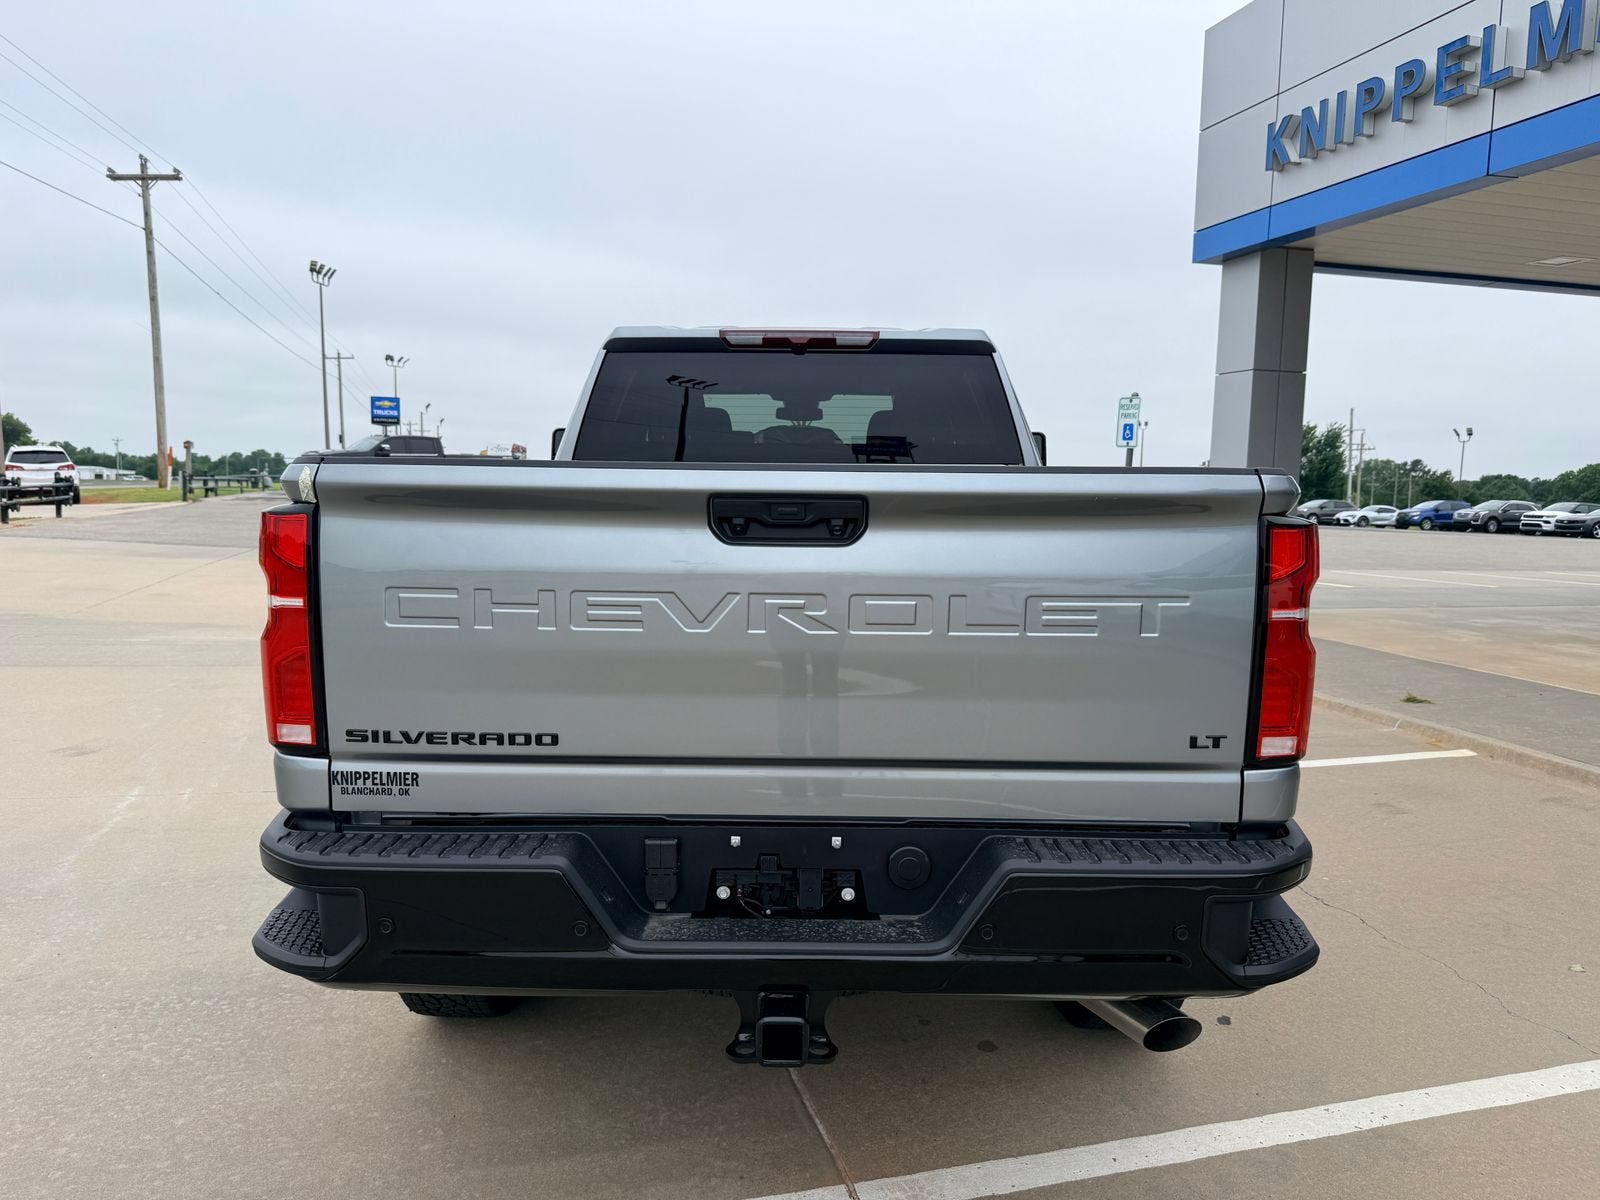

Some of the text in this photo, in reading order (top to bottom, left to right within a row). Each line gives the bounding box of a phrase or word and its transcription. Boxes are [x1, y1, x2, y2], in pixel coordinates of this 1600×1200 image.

[1265, 0, 1600, 172] KNIPPELM
[384, 586, 1191, 637] CHEVROLET
[345, 728, 559, 747] SILVERADO
[1189, 735, 1228, 749] LT
[331, 770, 420, 787] KNIPPELMIER
[340, 786, 411, 797] BLANCHARD, OK
